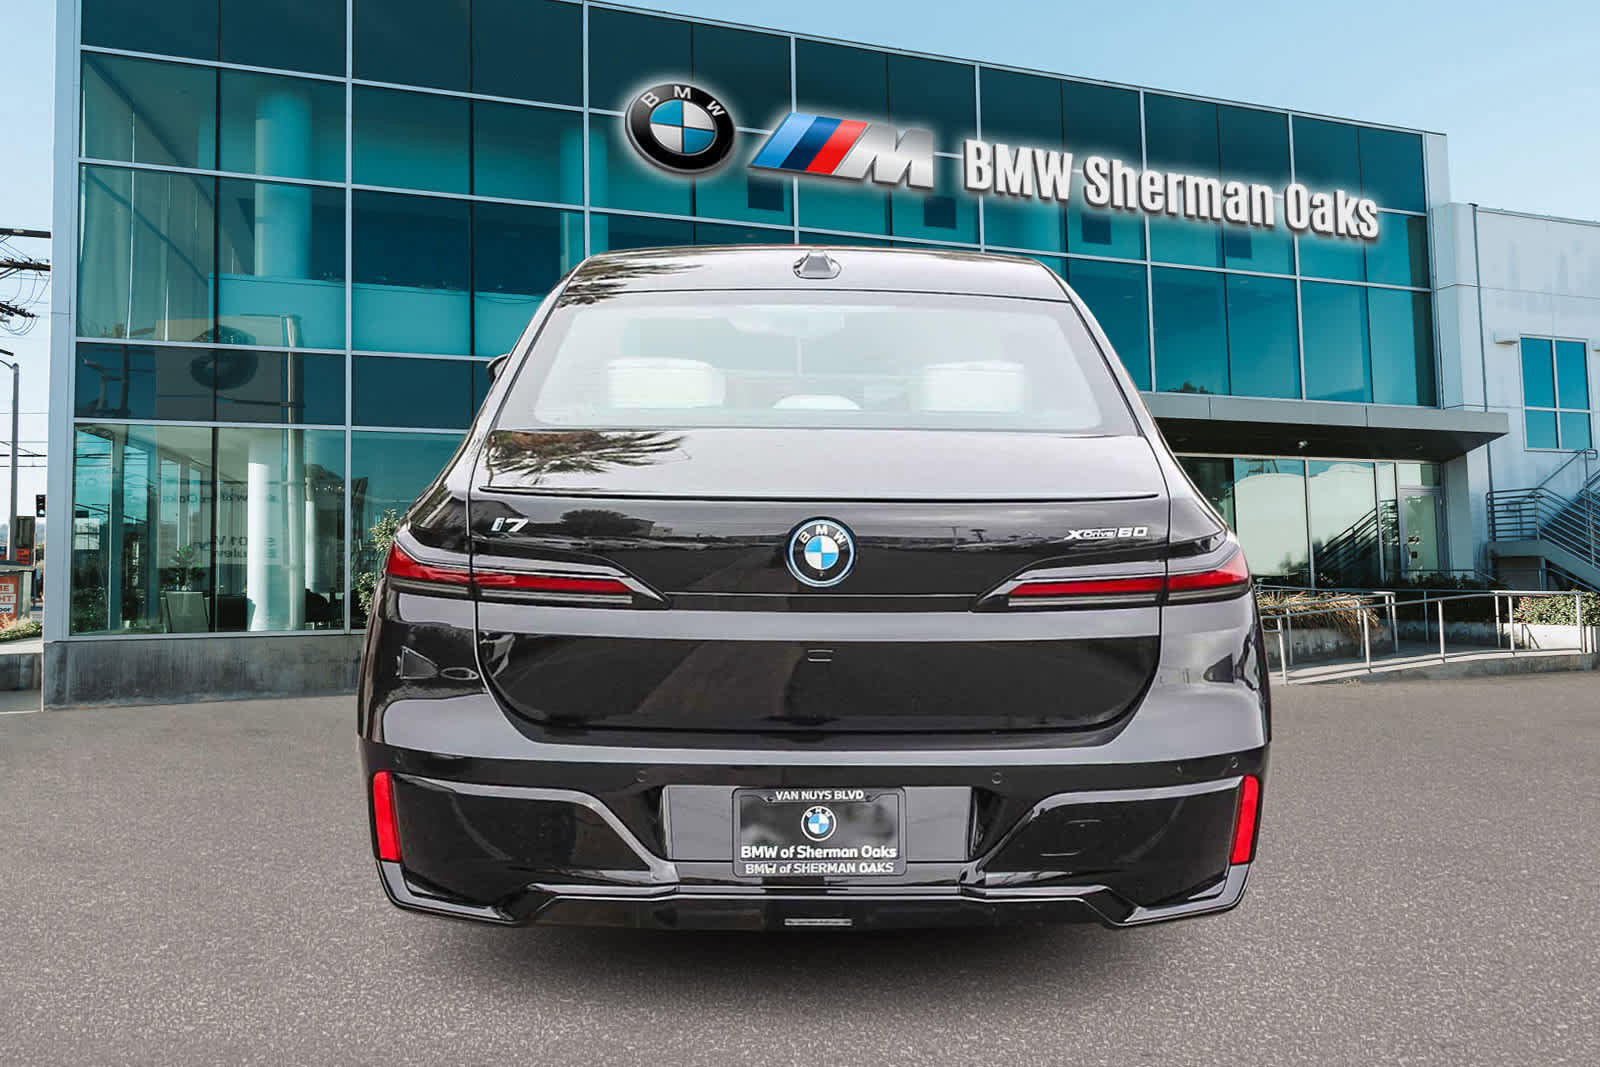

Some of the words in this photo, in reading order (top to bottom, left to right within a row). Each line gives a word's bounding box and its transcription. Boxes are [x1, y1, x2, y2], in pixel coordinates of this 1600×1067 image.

[641, 85, 726, 118] BMW
[963, 138, 1074, 202] BMW
[1083, 156, 1278, 227] Sherman
[1284, 183, 1380, 240] Oaks
[799, 525, 848, 545] BMW
[775, 790, 799, 801] VAN
[801, 790, 832, 801] NUYS
[834, 790, 864, 800] BLVD
[741, 845, 777, 859] BMW
[780, 845, 796, 859] of
[797, 845, 858, 859] Sherman
[861, 845, 897, 859] Oaks
[745, 863, 777, 875] BMW
[779, 863, 793, 874] of
[793, 862, 856, 874] SHERMAN
[859, 862, 894, 874] OAKS
